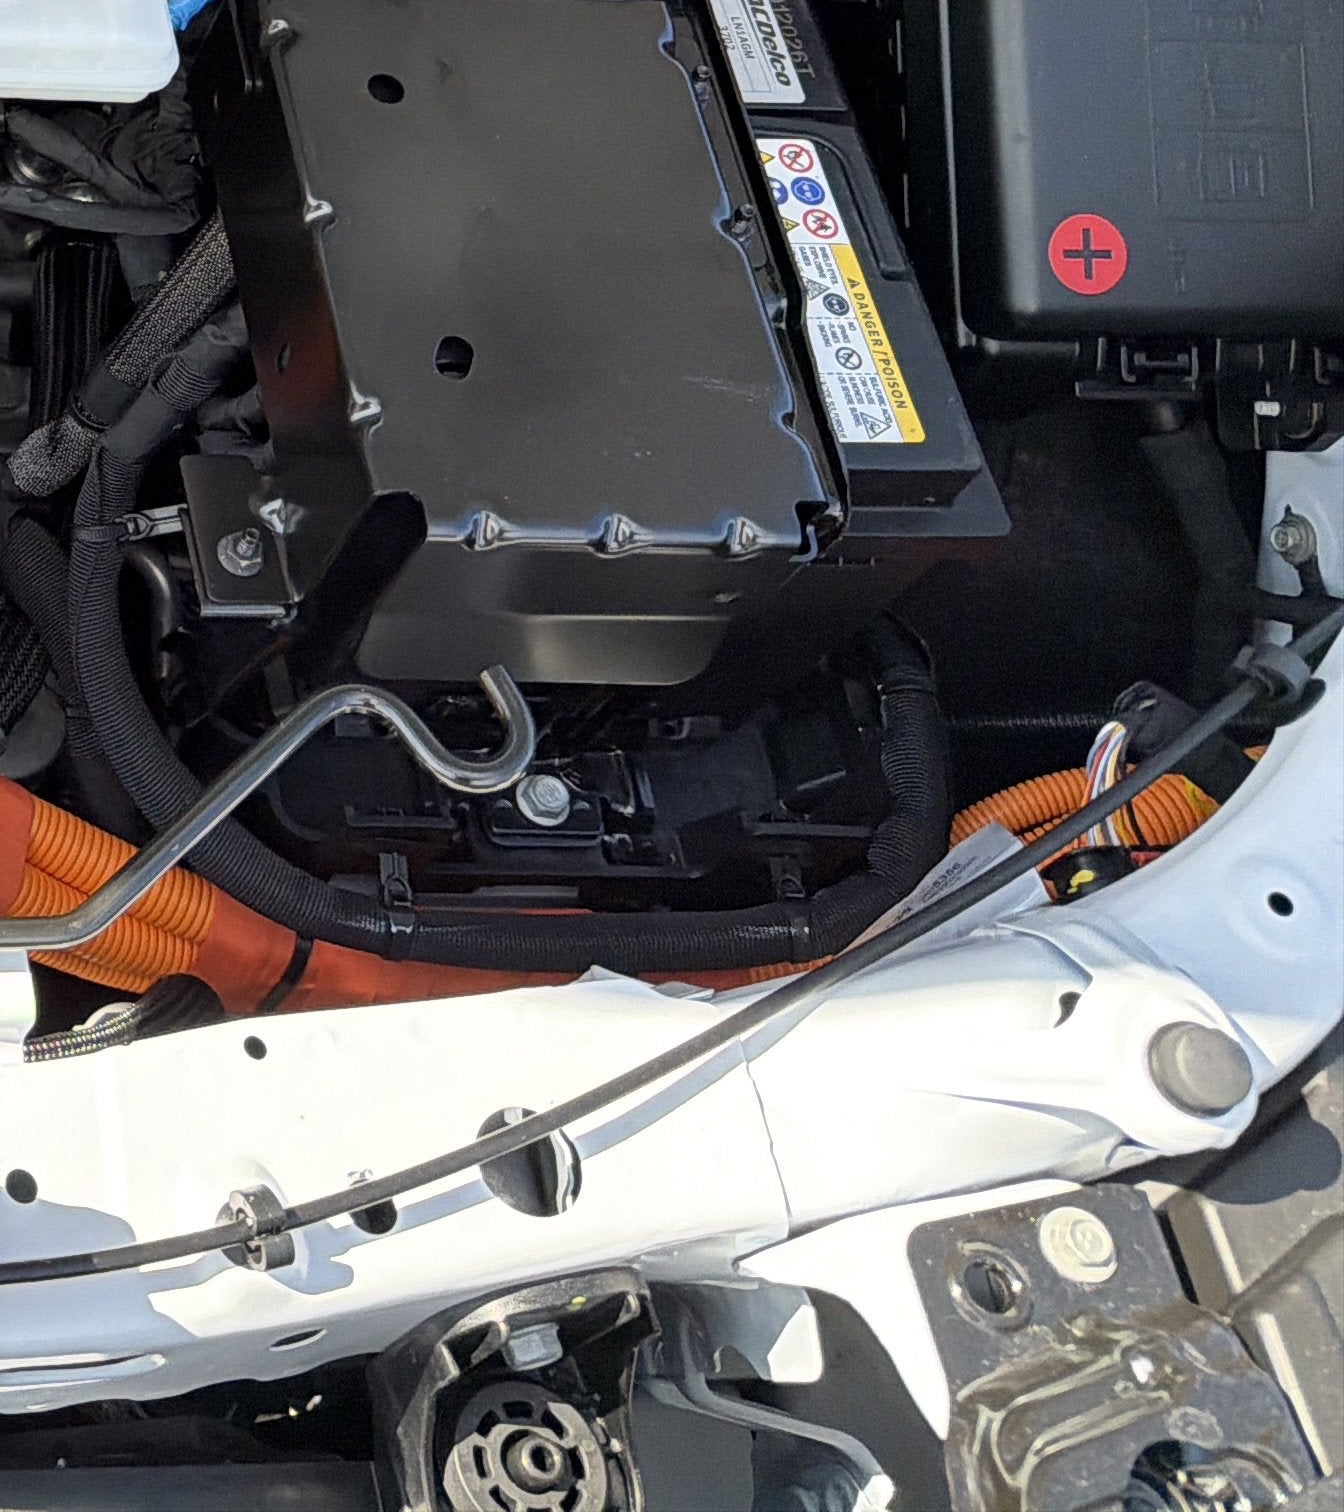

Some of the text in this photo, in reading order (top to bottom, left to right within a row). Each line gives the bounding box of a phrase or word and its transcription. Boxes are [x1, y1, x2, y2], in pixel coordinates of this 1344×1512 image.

[730, 16, 755, 59] LN1AGM
[853, 293, 884, 346] DANGER
[878, 359, 908, 408] POISON
